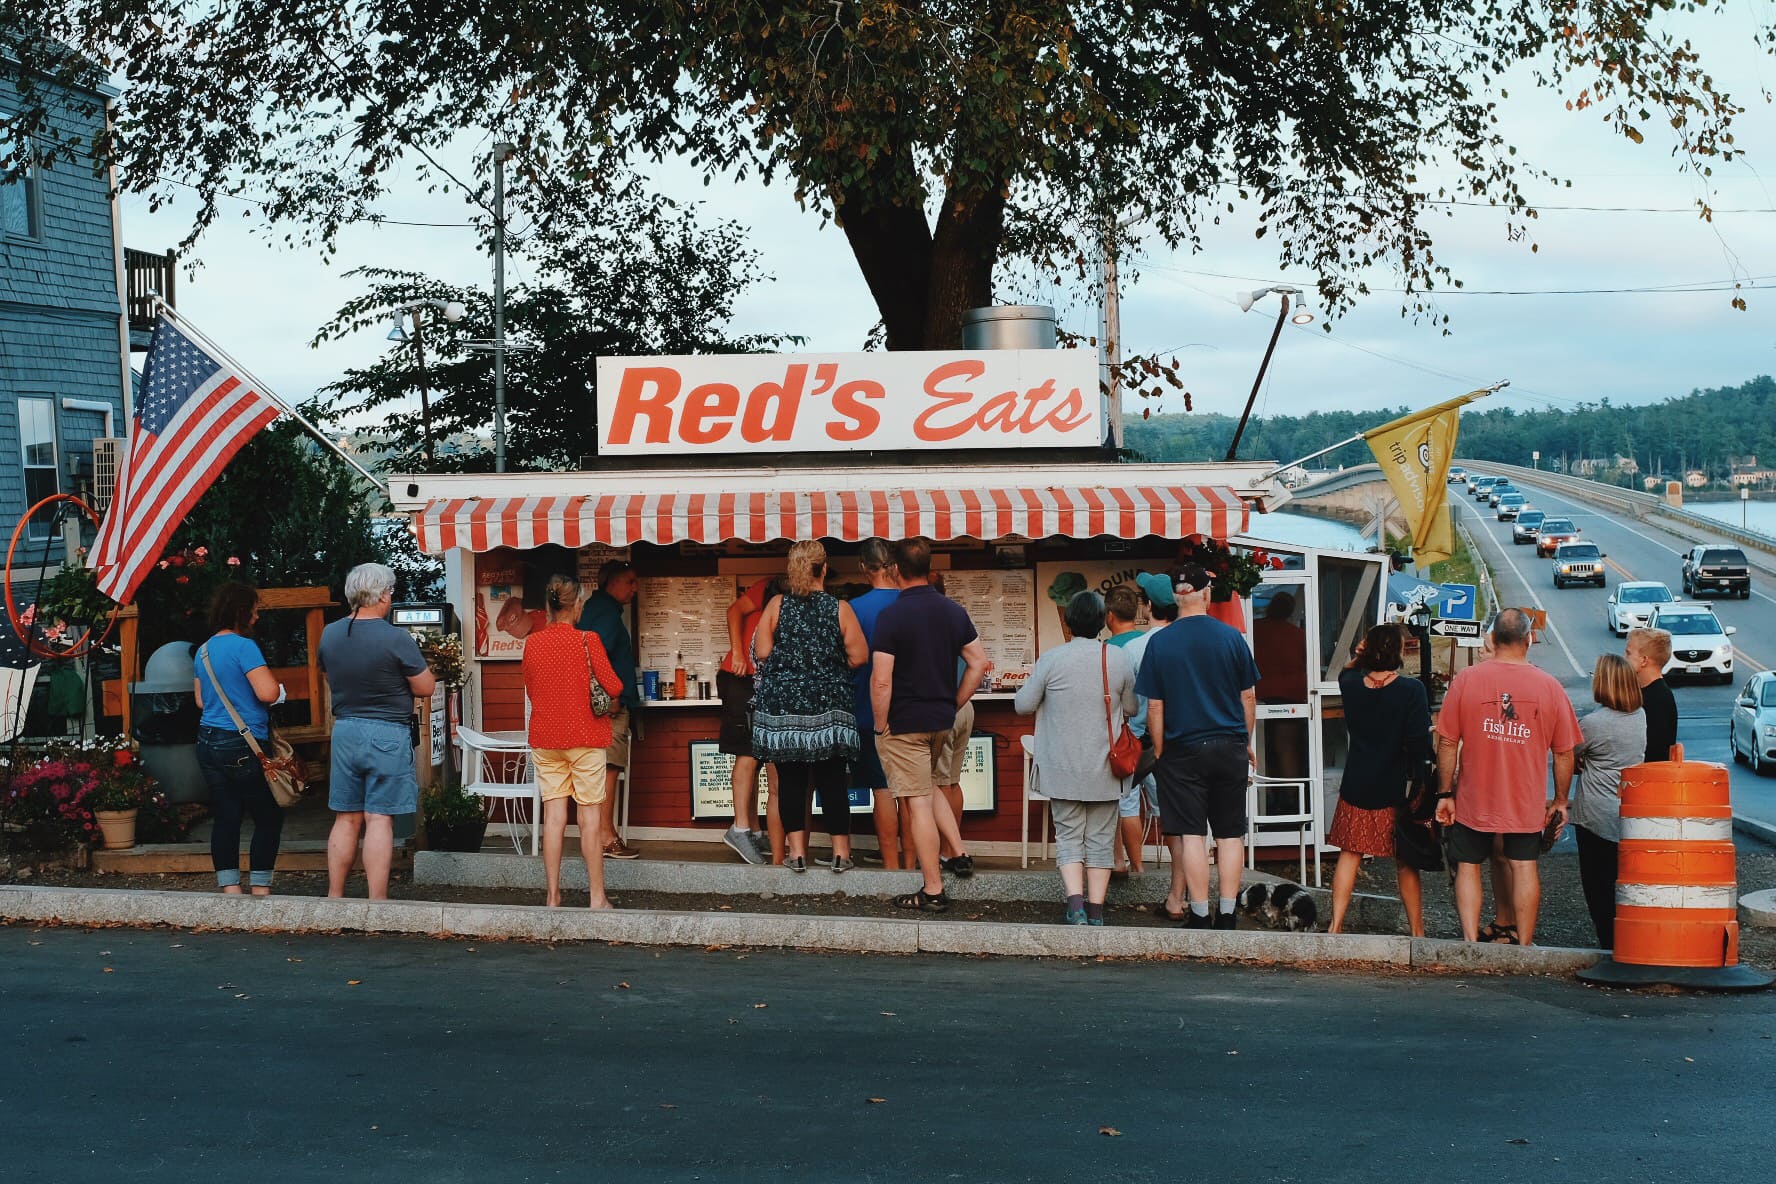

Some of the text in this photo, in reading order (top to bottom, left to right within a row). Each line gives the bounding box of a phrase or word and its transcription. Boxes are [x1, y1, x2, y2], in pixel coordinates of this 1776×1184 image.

[606, 359, 1092, 445] Red's Eats
[407, 611, 432, 621] ATM
[1444, 624, 1475, 633] ONE WAY
[491, 639, 524, 652] Red's
[1002, 672, 1031, 680] Red'
[1482, 717, 1532, 739] fish life
